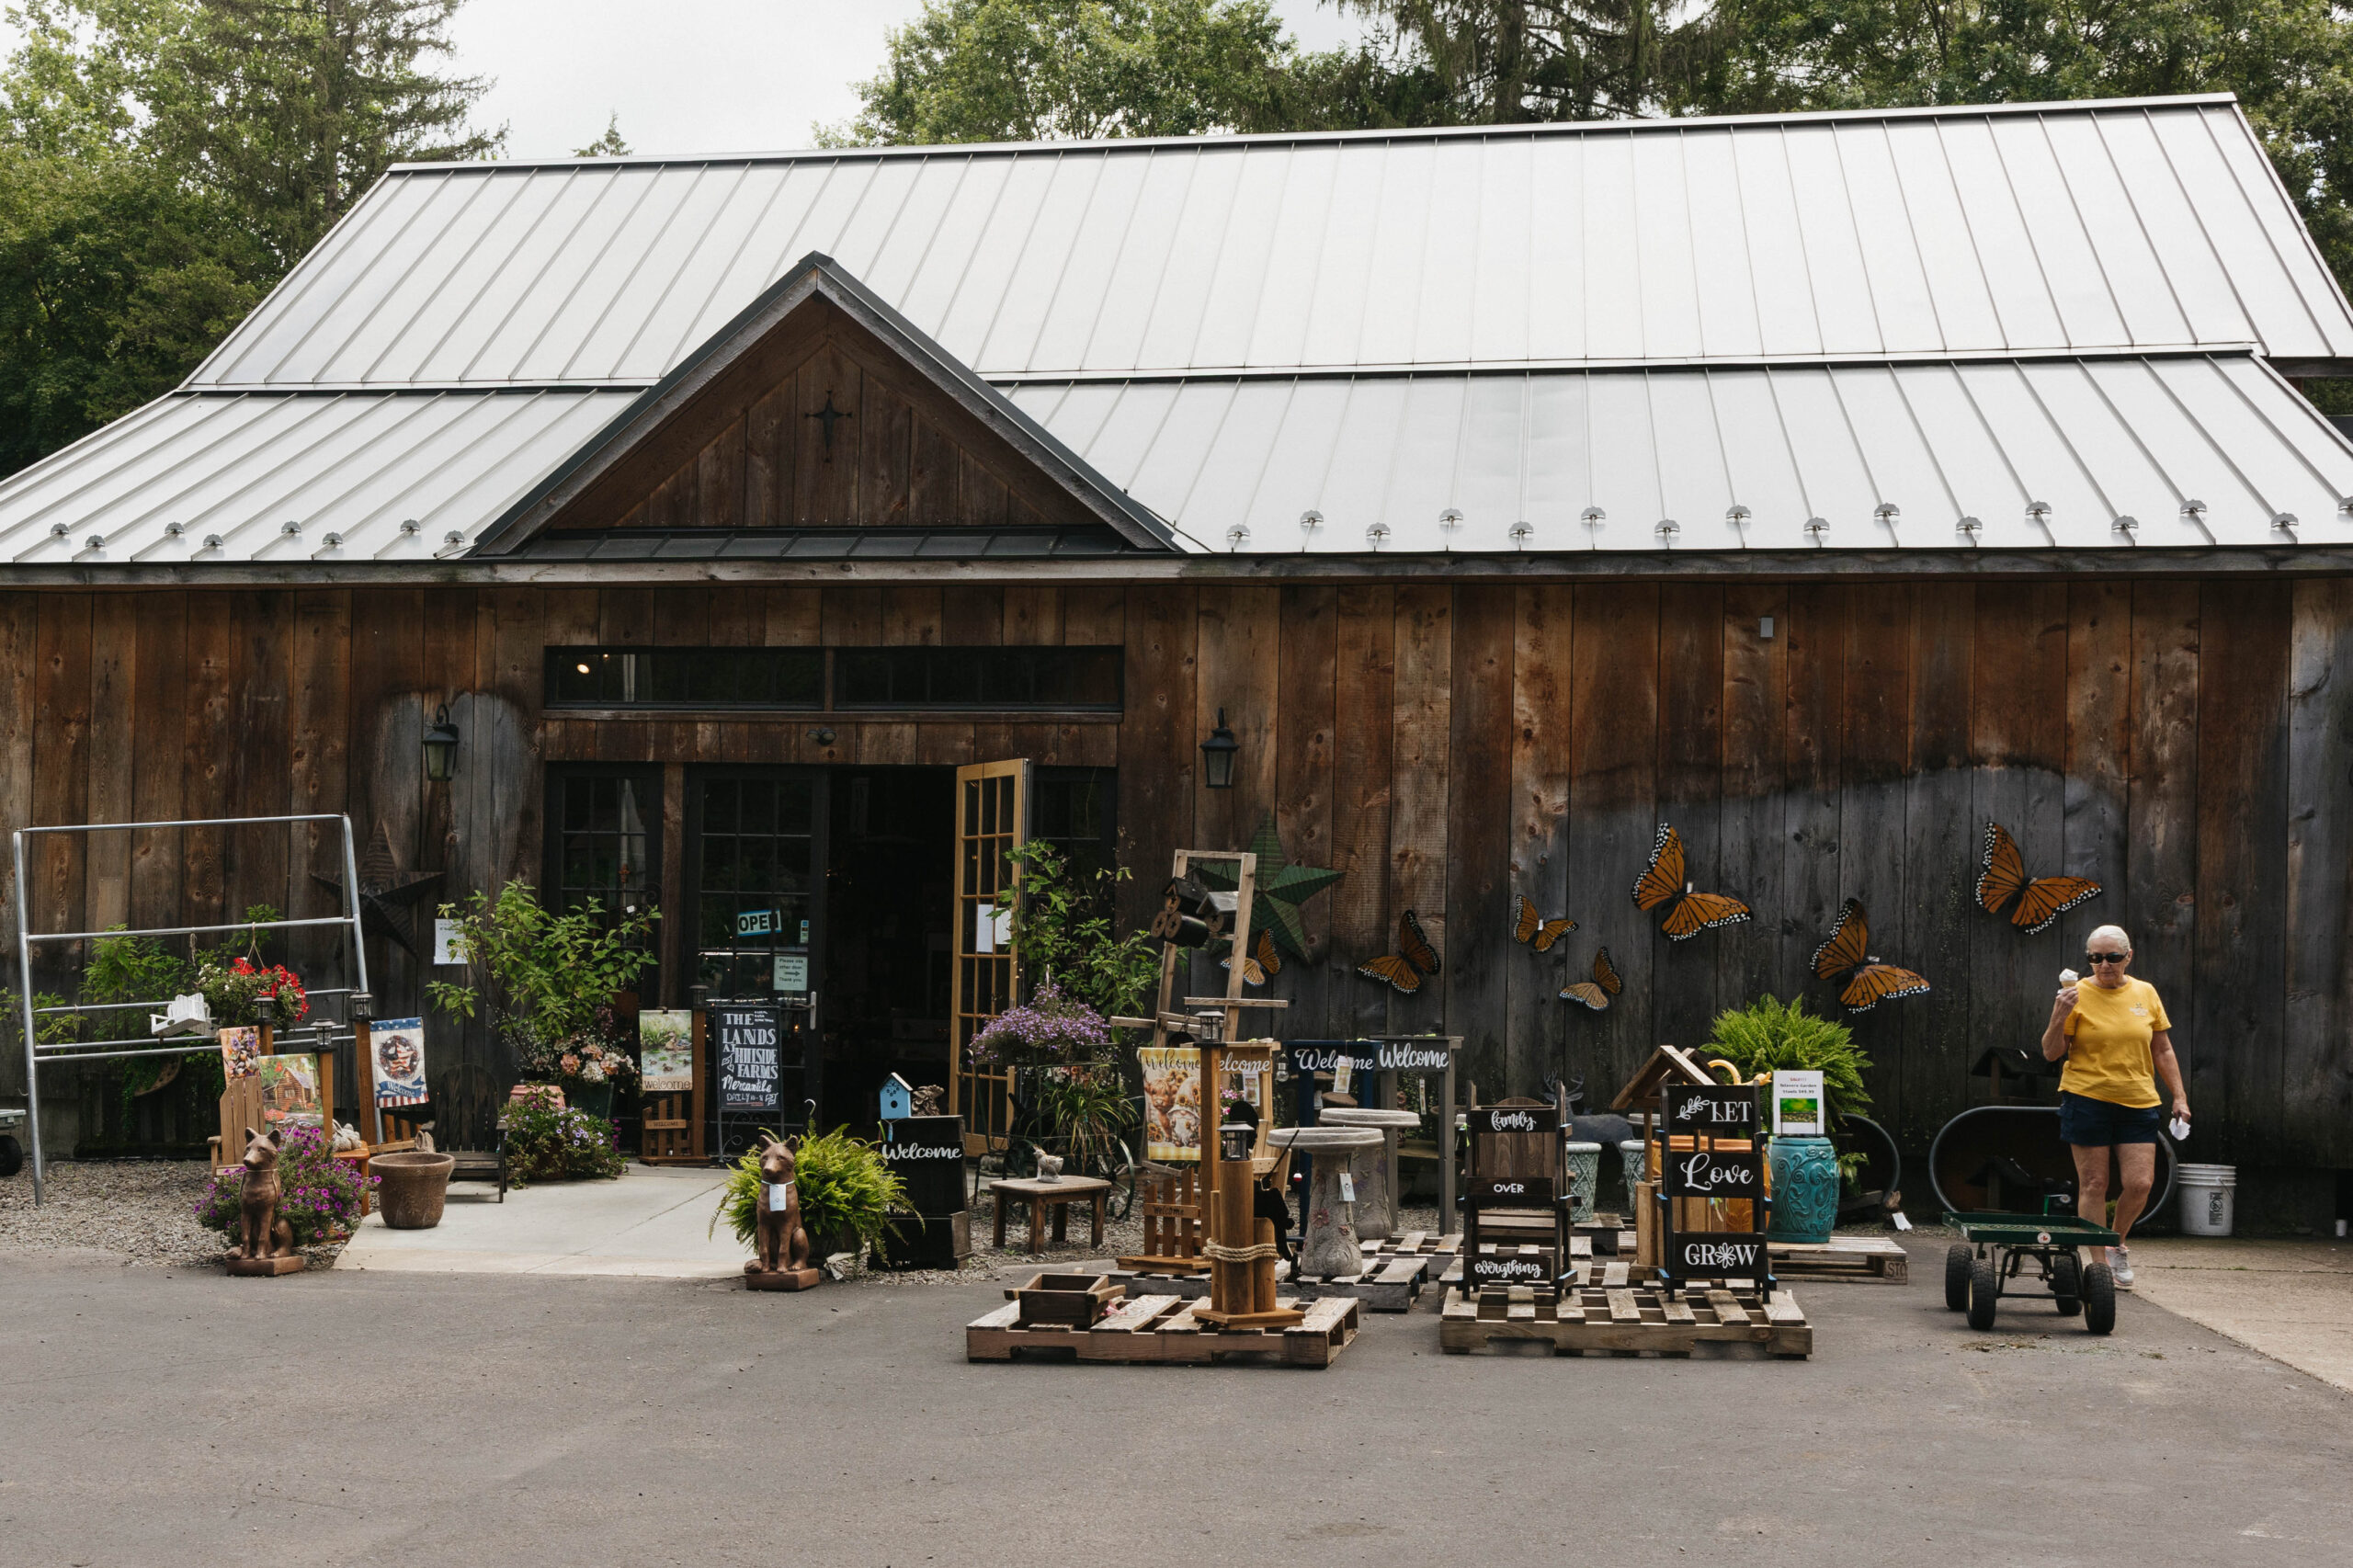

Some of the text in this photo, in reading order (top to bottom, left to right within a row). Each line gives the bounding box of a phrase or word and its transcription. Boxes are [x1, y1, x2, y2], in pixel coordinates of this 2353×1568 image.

[722, 1013, 754, 1026] THE
[722, 1028, 777, 1045] LANDS
[722, 1044, 736, 1052] AT
[734, 1048, 778, 1064] HILLSIDE
[1379, 1042, 1449, 1069] Welcome
[1145, 1049, 1200, 1071] Welcome
[1219, 1051, 1270, 1072] elcome
[1294, 1048, 1374, 1071] Welcme
[737, 1063, 779, 1080] FARMS
[387, 1081, 415, 1097] Welcome
[643, 1078, 691, 1090] welcome
[722, 1074, 772, 1093] Mercantile
[726, 1093, 750, 1103] DAILY
[1491, 1110, 1537, 1131] family
[1710, 1101, 1753, 1122] LET
[881, 1142, 962, 1160] Welcome
[1680, 1153, 1754, 1190] Love
[1494, 1183, 1525, 1193] OVER
[1474, 1259, 1543, 1278] everything
